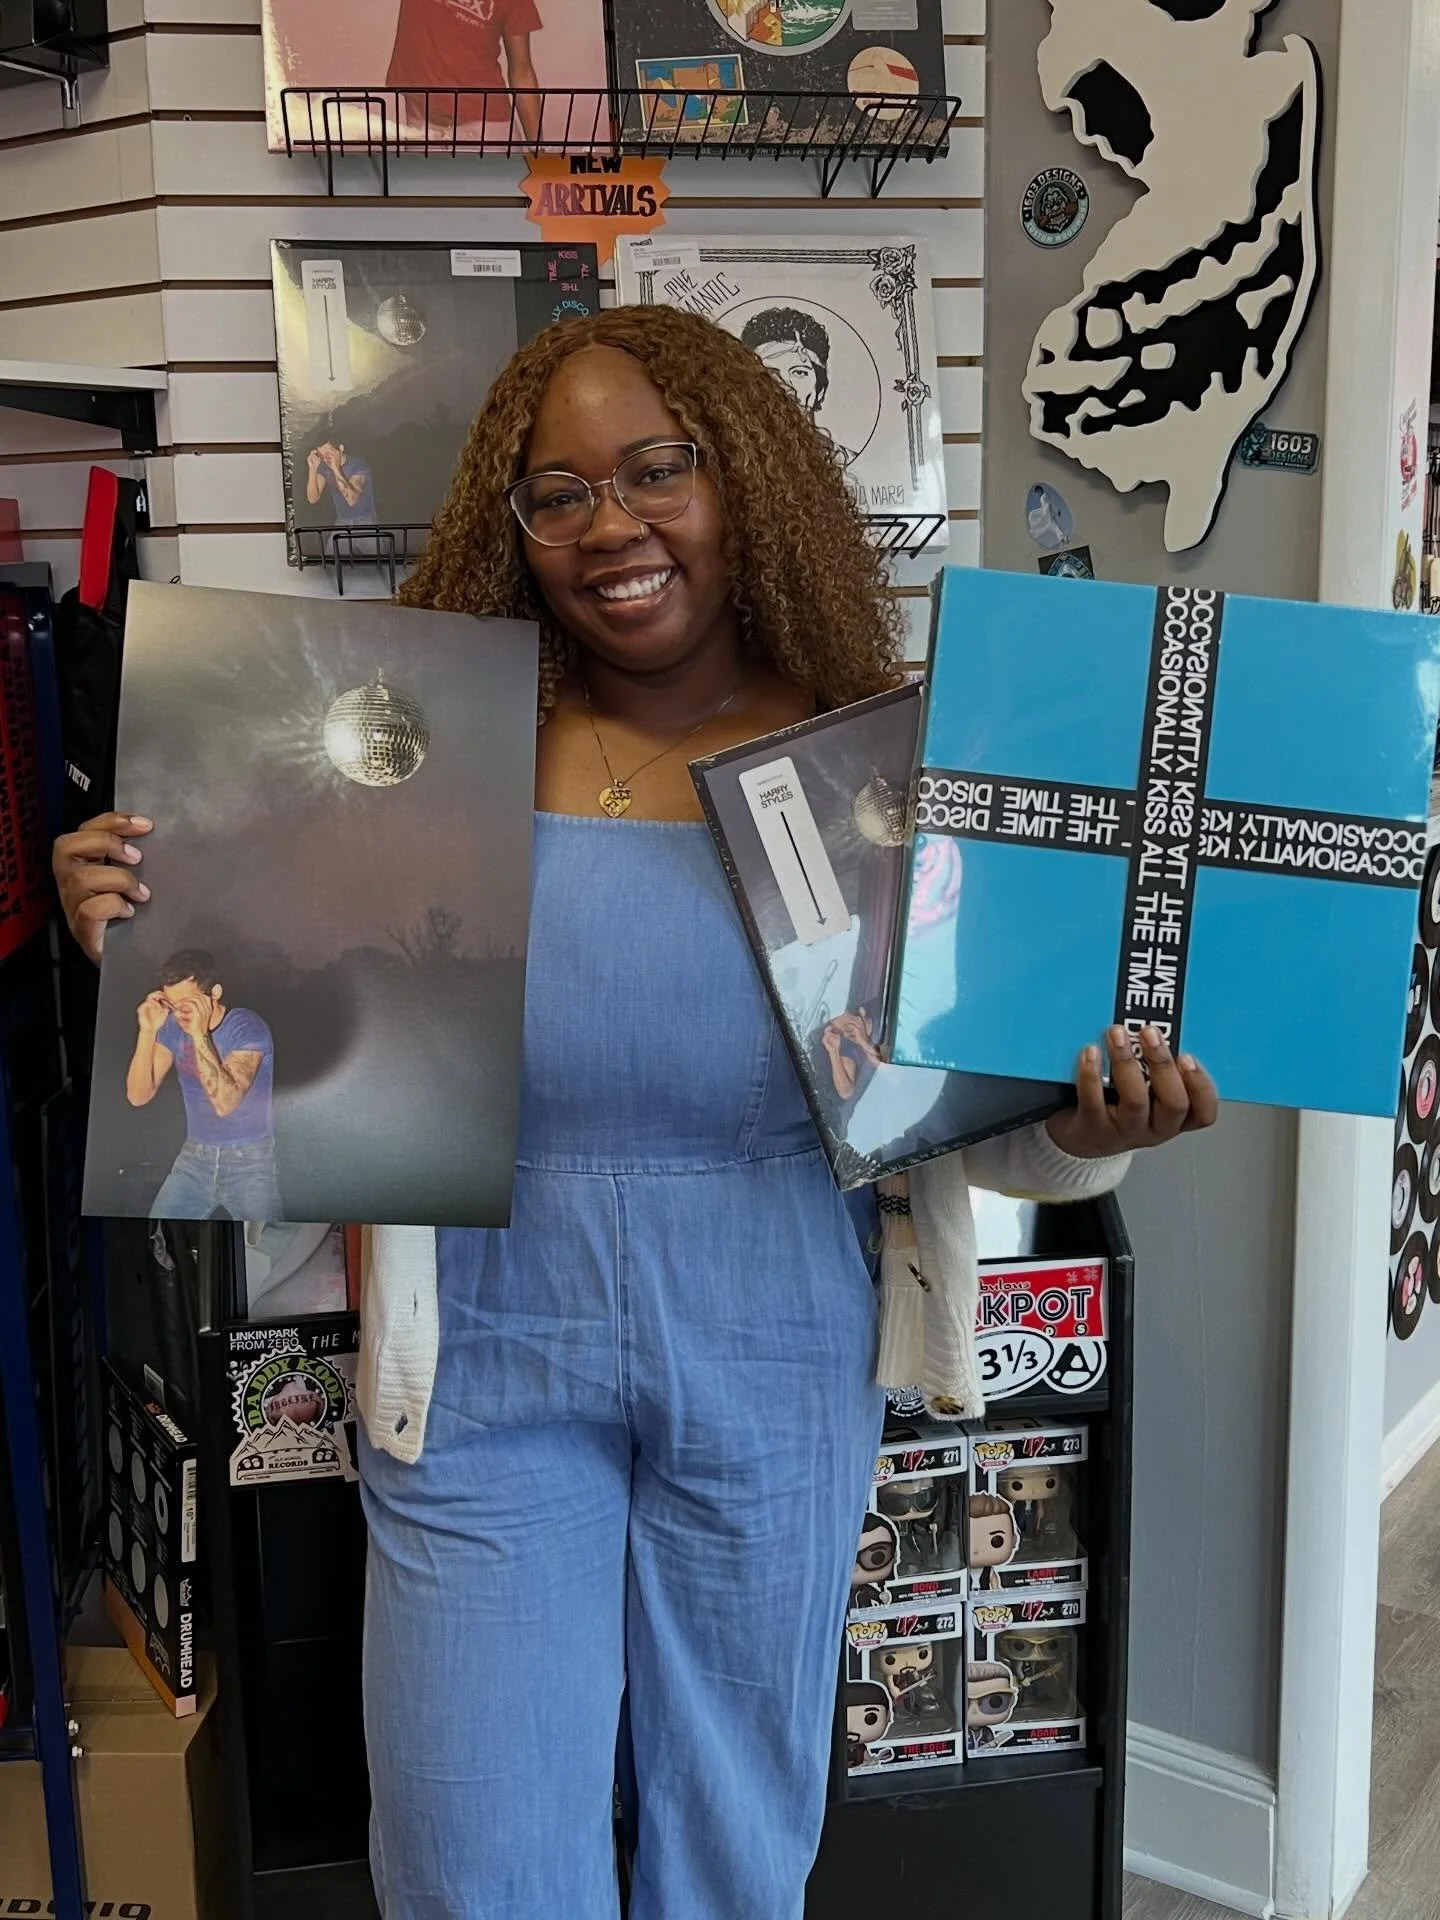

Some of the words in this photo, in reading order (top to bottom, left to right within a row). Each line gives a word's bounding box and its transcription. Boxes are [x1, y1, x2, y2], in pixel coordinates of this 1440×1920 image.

[570, 155, 623, 174] NEW
[535, 182, 657, 217] ARRIVALS
[1023, 182, 1039, 211] 1603
[1037, 169, 1083, 191] DESIGNS
[558, 250, 578, 260] KISS
[548, 259, 558, 283] TIME
[580, 264, 591, 280] ALL
[561, 282, 579, 292] THE
[664, 269, 698, 302] THE
[1271, 433, 1313, 454] 1603
[871, 485, 905, 505] MARS
[1149, 586, 1190, 773] OCCASIONALLY.
[759, 784, 788, 800] HARRY
[761, 791, 794, 809] STYLES
[917, 776, 993, 806] DISCO
[1000, 785, 1064, 816] TIME.
[1068, 793, 1120, 821] THE
[1143, 779, 1170, 835] KISS
[1138, 840, 1164, 886] ALL
[1132, 890, 1159, 943] THE
[1125, 947, 1154, 1012] TIME.
[978, 1277, 1031, 1291] bulous
[975, 1287, 1092, 1327] KPOT
[229, 1330, 268, 1342] LINKIN
[268, 1328, 299, 1338] PARK
[230, 1339, 265, 1351] FROM
[267, 1337, 300, 1349] ZERO
[311, 1332, 340, 1350] THE
[246, 1357, 292, 1427] DADDY
[296, 1357, 344, 1408] KOOL
[155, 1414, 188, 1443] DRUMHEAD
[874, 1456, 893, 1475] P!
[943, 1449, 960, 1464] 271
[974, 1441, 1013, 1461] POP!
[1063, 1438, 1080, 1451] 273
[268, 1459, 309, 1470] RECORDS
[974, 1605, 1012, 1624] POP!
[1062, 1602, 1079, 1615] 270
[848, 1621, 887, 1641] POP!
[936, 1615, 954, 1629] 272
[180, 1612, 194, 1688] DRUMHEAD
